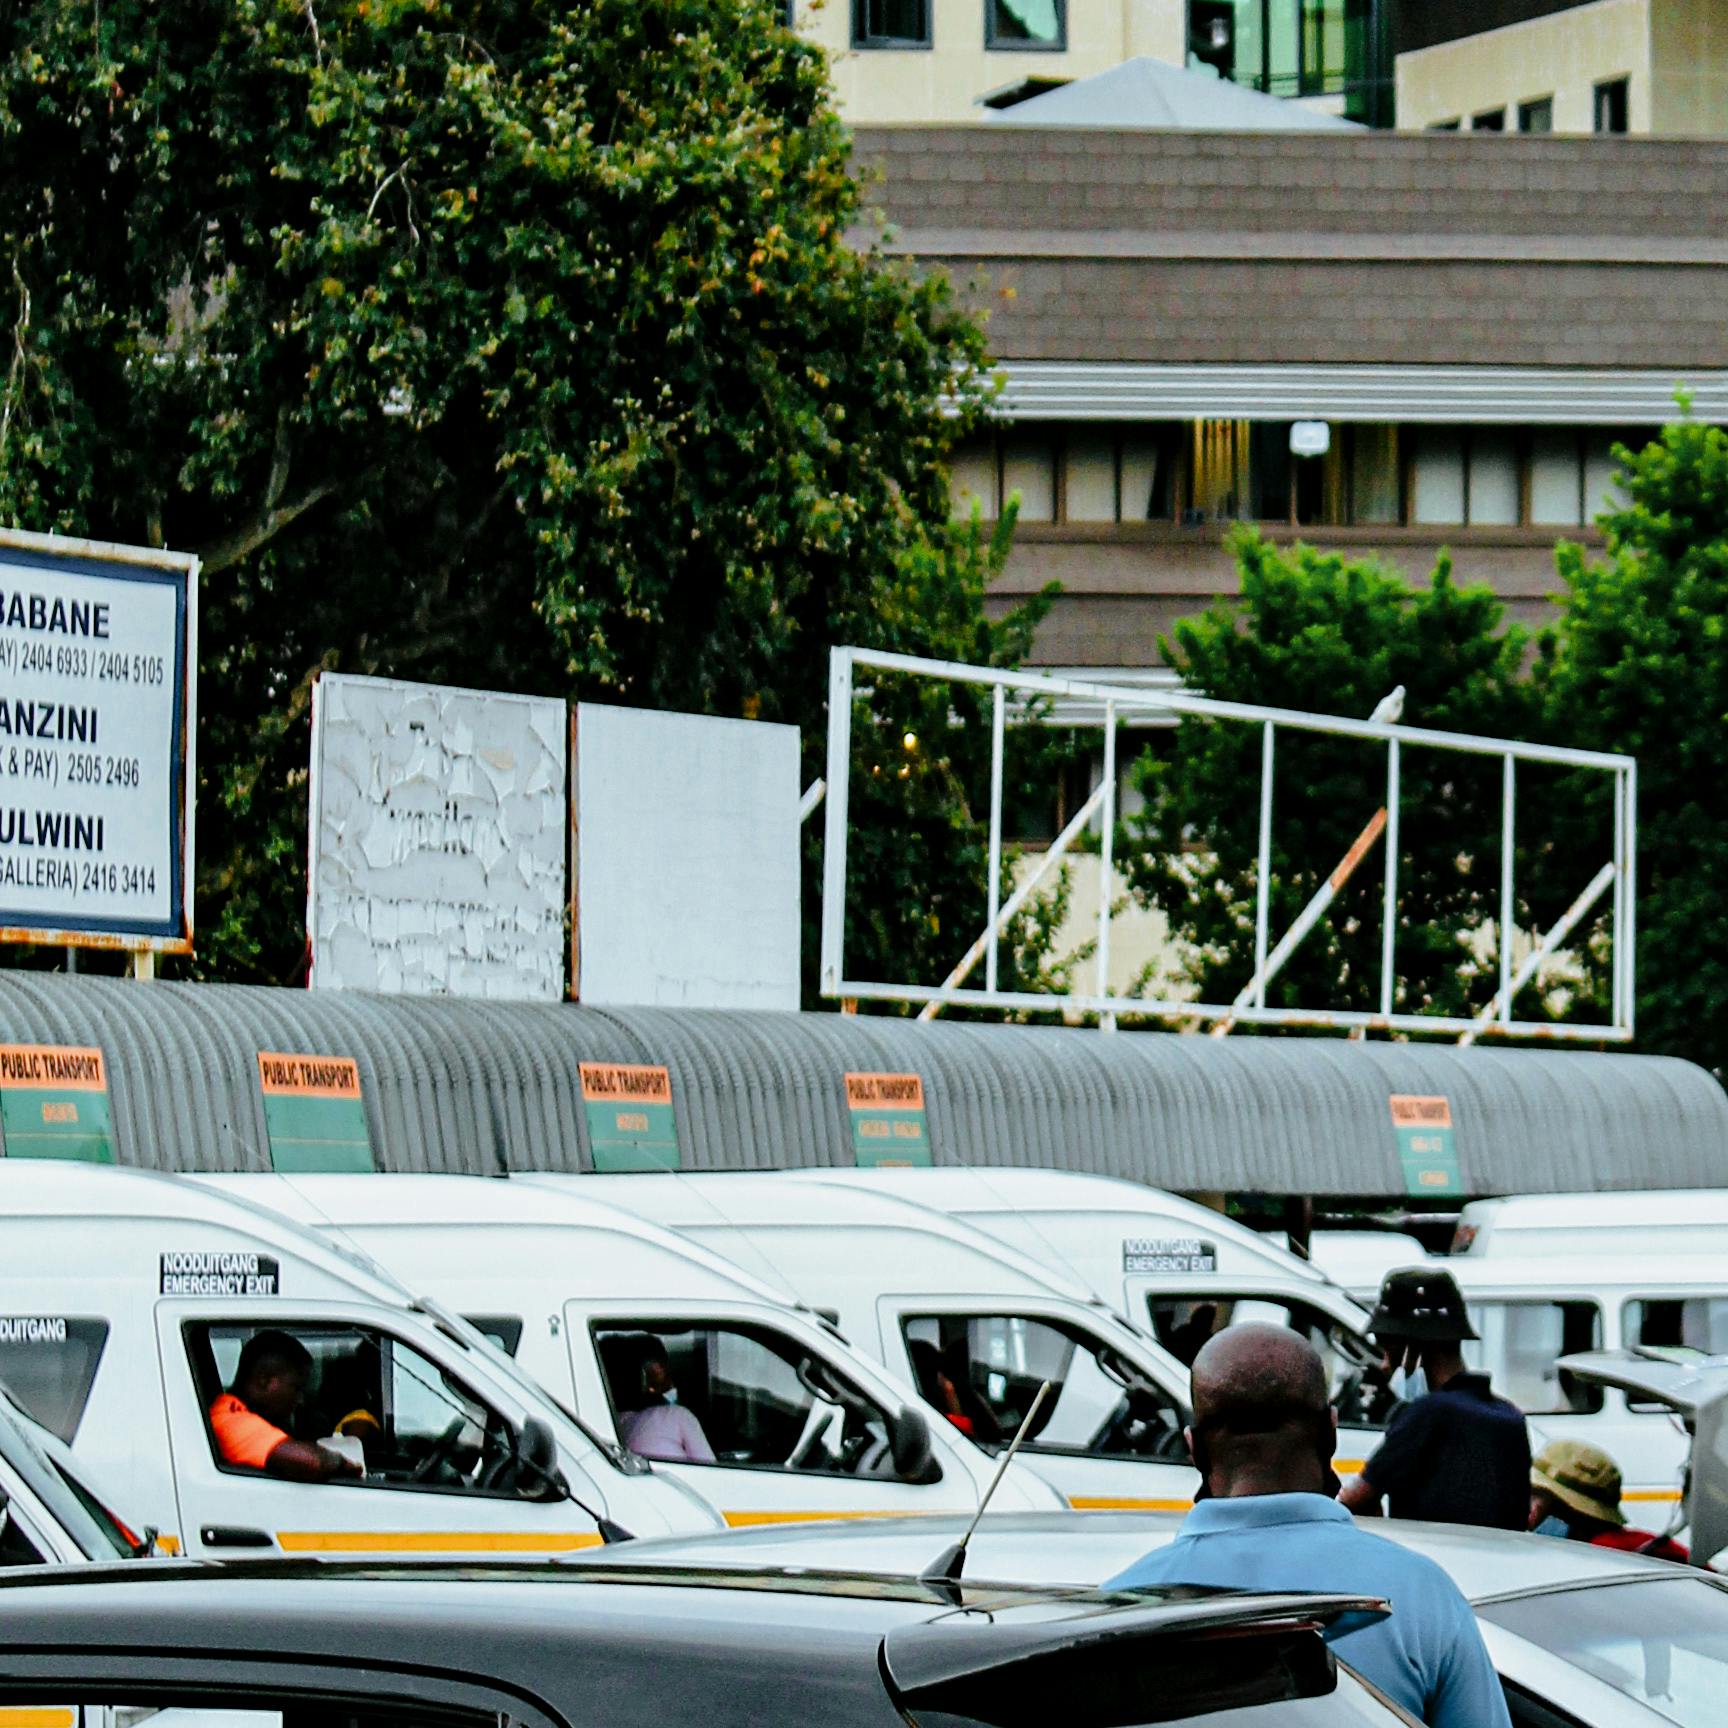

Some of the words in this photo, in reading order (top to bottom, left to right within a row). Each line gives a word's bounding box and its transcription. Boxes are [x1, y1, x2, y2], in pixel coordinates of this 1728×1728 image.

[0, 590, 110, 640] ABANE
[22, 641, 52, 671] 2404
[57, 645, 88, 677] 6933
[99, 651, 129, 681] 2404
[133, 655, 164, 684] 5105
[24, 748, 59, 788] PAY)
[67, 752, 101, 784] 2505
[106, 756, 140, 787] 2496
[83, 861, 117, 893] 2416
[121, 864, 156, 894] 3414
[0, 1052, 41, 1079] PUBLIC
[42, 1053, 100, 1081] TRANSPORT
[263, 1060, 299, 1087] PUBLIC
[299, 1062, 355, 1089] TRANSPORT
[583, 1070, 617, 1092] PUBLIC
[617, 1070, 668, 1096] TRANSPORT
[163, 1253, 259, 1274] NOODUITGANG
[163, 1274, 244, 1294] EMERGENCY
[246, 1274, 275, 1294] EXIT
